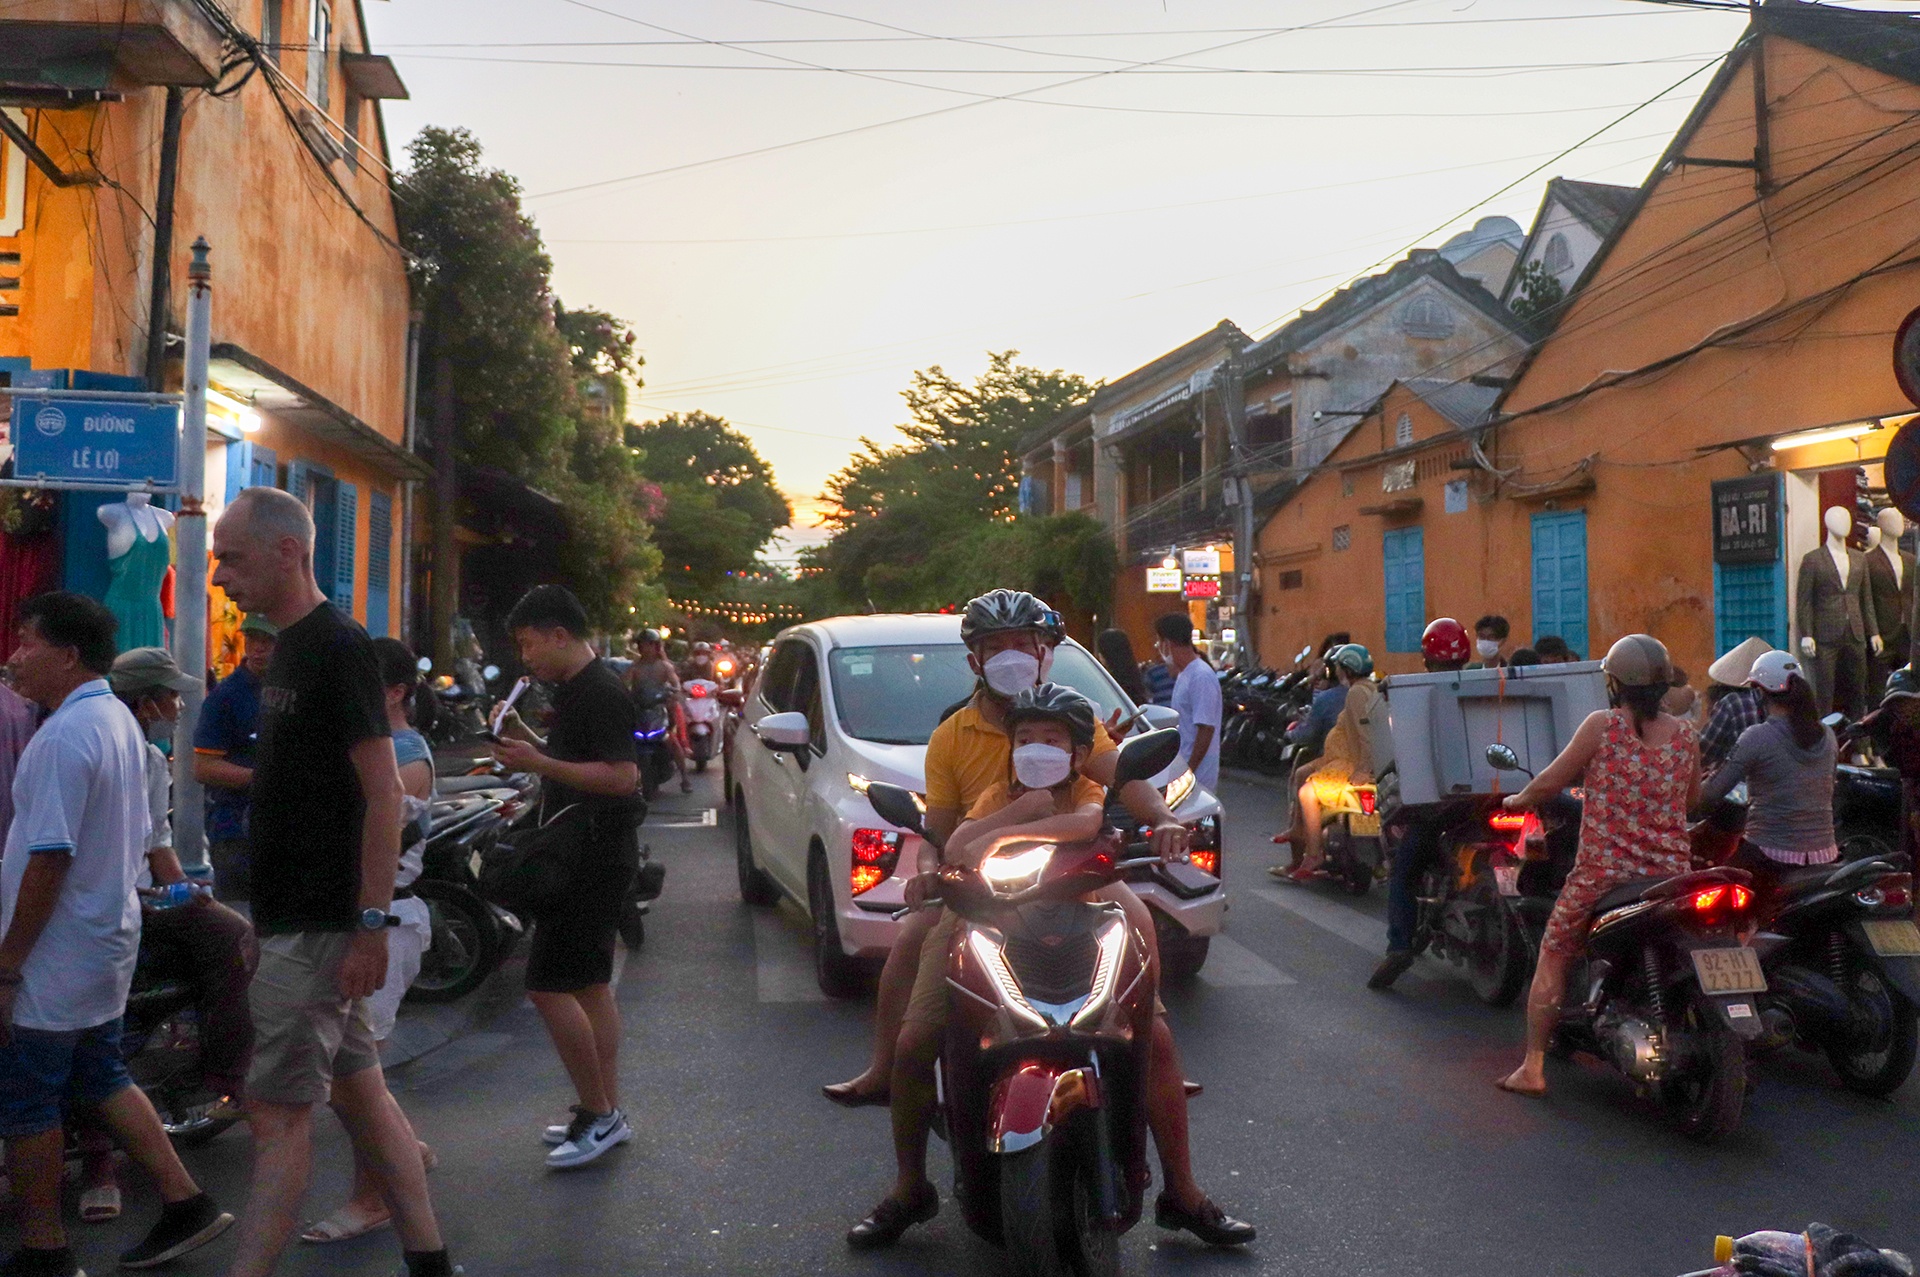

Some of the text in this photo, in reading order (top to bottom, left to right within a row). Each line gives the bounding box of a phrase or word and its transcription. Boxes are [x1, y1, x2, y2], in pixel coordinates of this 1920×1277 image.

[73, 446, 119, 473] LÊ LỢI
[1187, 582, 1218, 595] CAMERA
[1702, 951, 1749, 971] 92-H1
